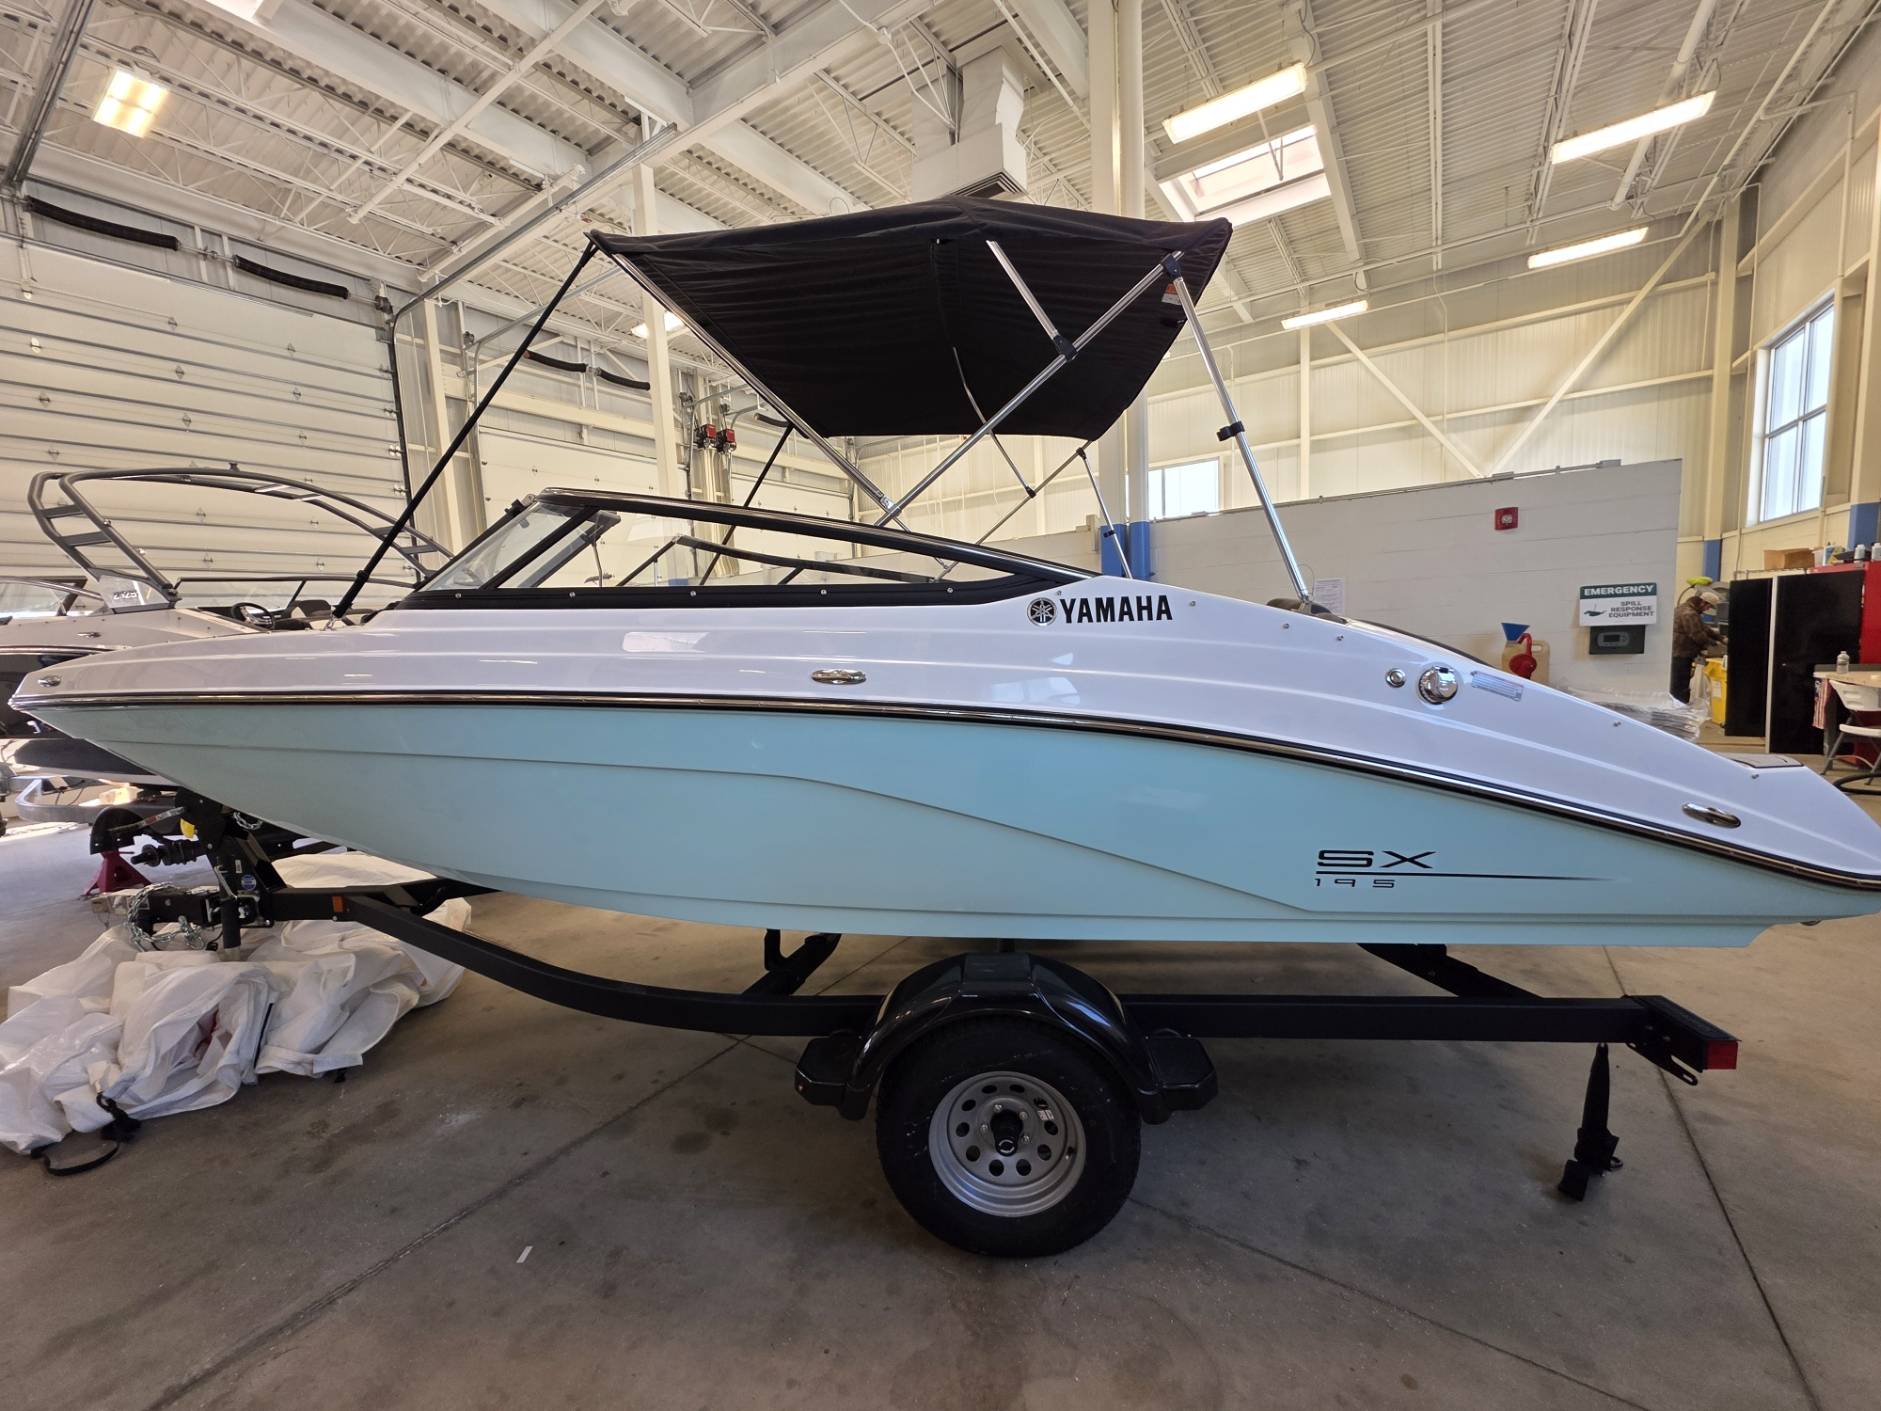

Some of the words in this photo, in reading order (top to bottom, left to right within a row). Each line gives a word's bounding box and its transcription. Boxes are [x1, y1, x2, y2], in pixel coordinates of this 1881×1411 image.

[1584, 584, 1654, 596] EMERGENCY
[1059, 595, 1173, 624] YAMAHA
[1317, 850, 1437, 868] SX
[1314, 878, 1396, 888] 195
